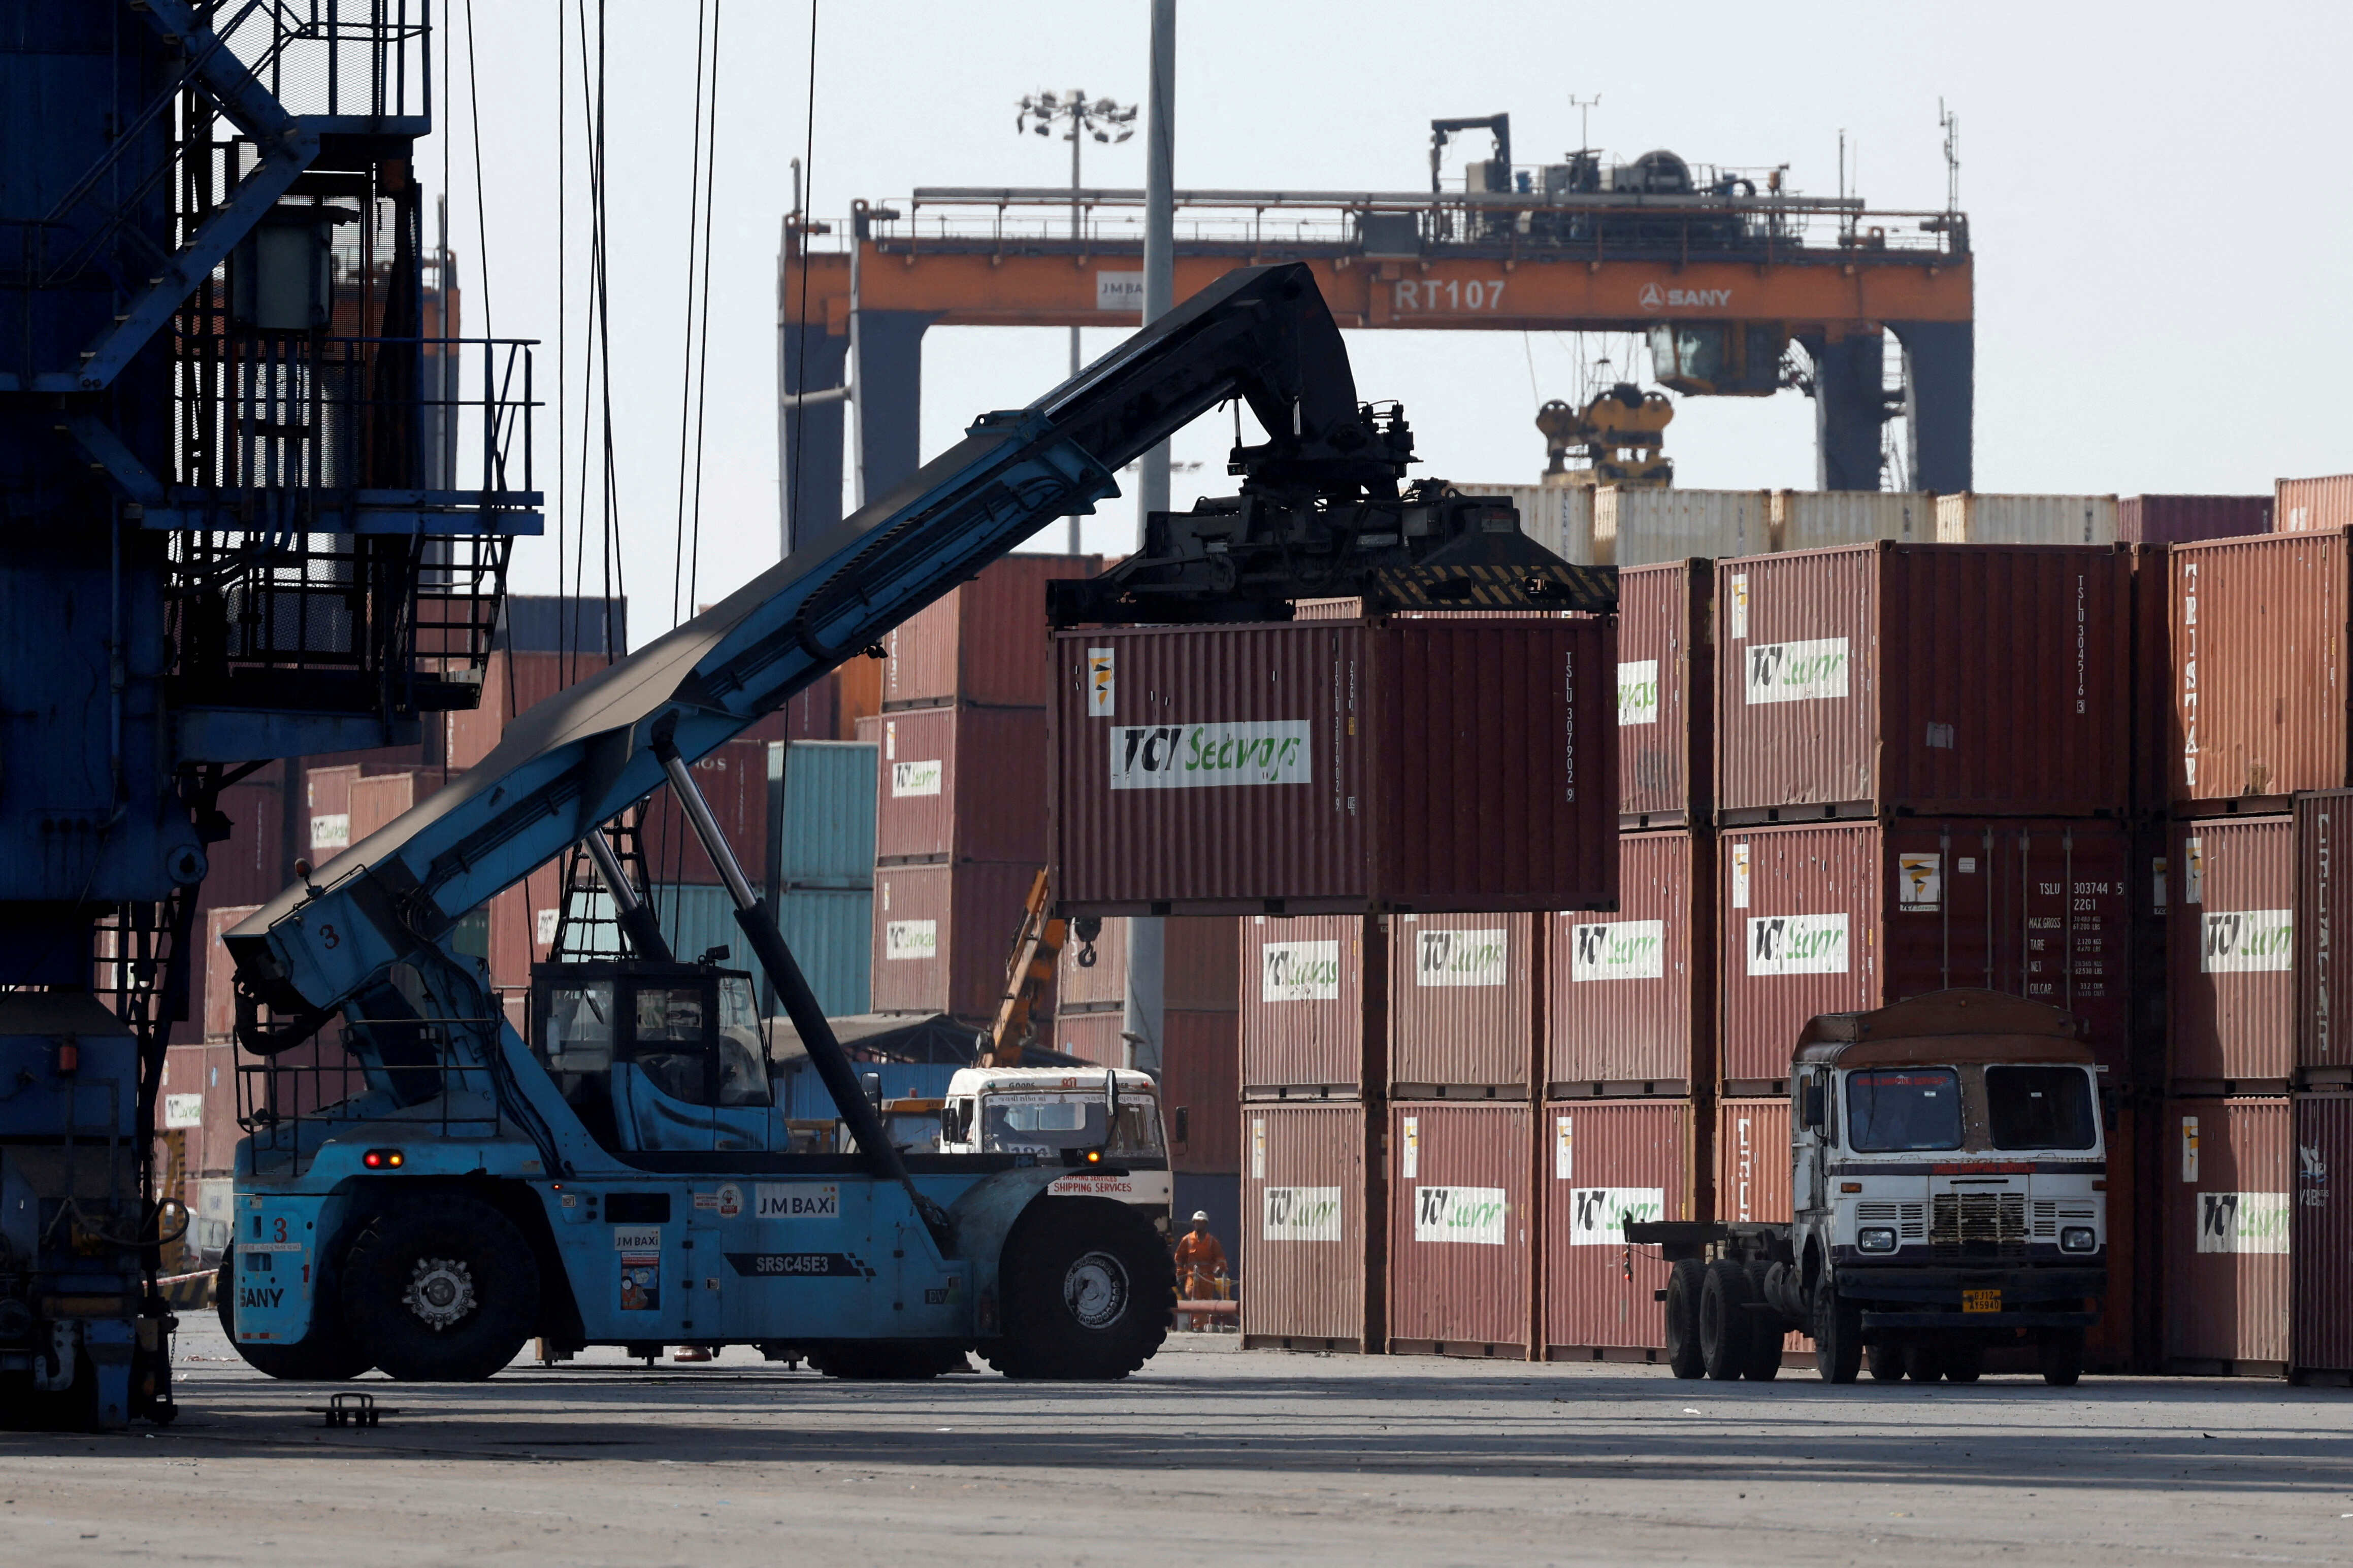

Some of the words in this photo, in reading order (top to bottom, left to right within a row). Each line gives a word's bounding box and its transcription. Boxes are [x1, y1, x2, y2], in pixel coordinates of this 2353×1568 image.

[1395, 280, 1505, 310] RT107
[1668, 289, 1731, 306] SANY
[1125, 728, 1182, 772] TCI
[1185, 726, 1300, 781] Seaways
[2039, 883, 2060, 894] TSLU
[2074, 882, 2108, 894] 303744
[2117, 883, 2123, 894] 5
[2074, 898, 2096, 911] 22G1
[319, 923, 340, 950] 3
[2030, 939, 2045, 951] TARE
[1054, 1183, 1092, 1192] SHIPPING
[1095, 1183, 1132, 1192] SERVICES
[274, 1217, 288, 1243] 3
[756, 1256, 829, 1272] SRSC45E3
[1974, 1291, 1994, 1300] GJ12
